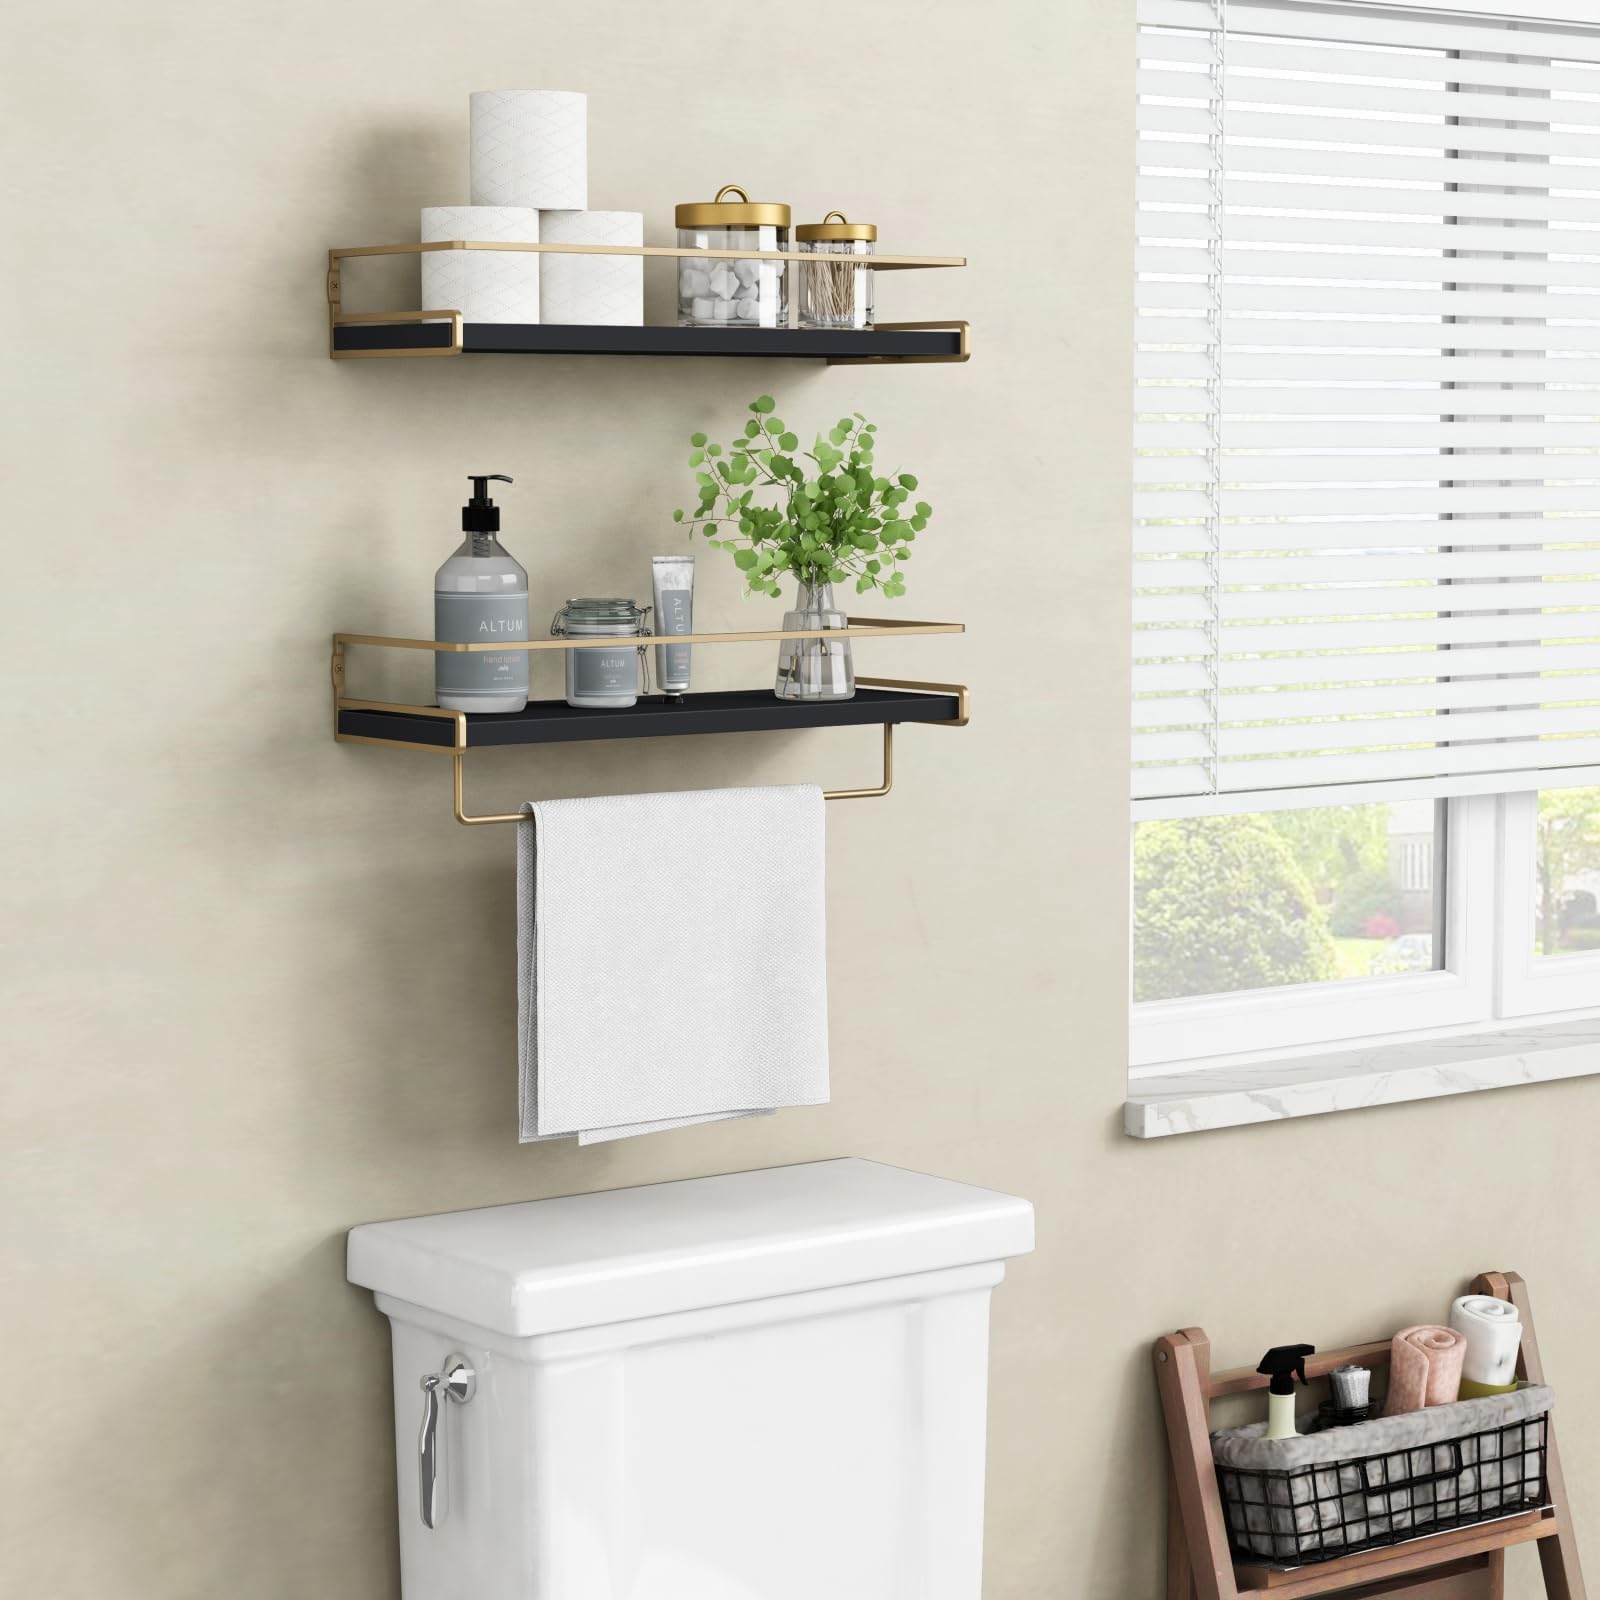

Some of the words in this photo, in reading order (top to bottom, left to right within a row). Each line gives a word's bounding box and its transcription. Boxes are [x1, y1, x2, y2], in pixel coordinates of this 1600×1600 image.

[673, 597, 685, 632] ALTU
[479, 619, 523, 632] ALTUM
[600, 659, 625, 668] ALTUM
